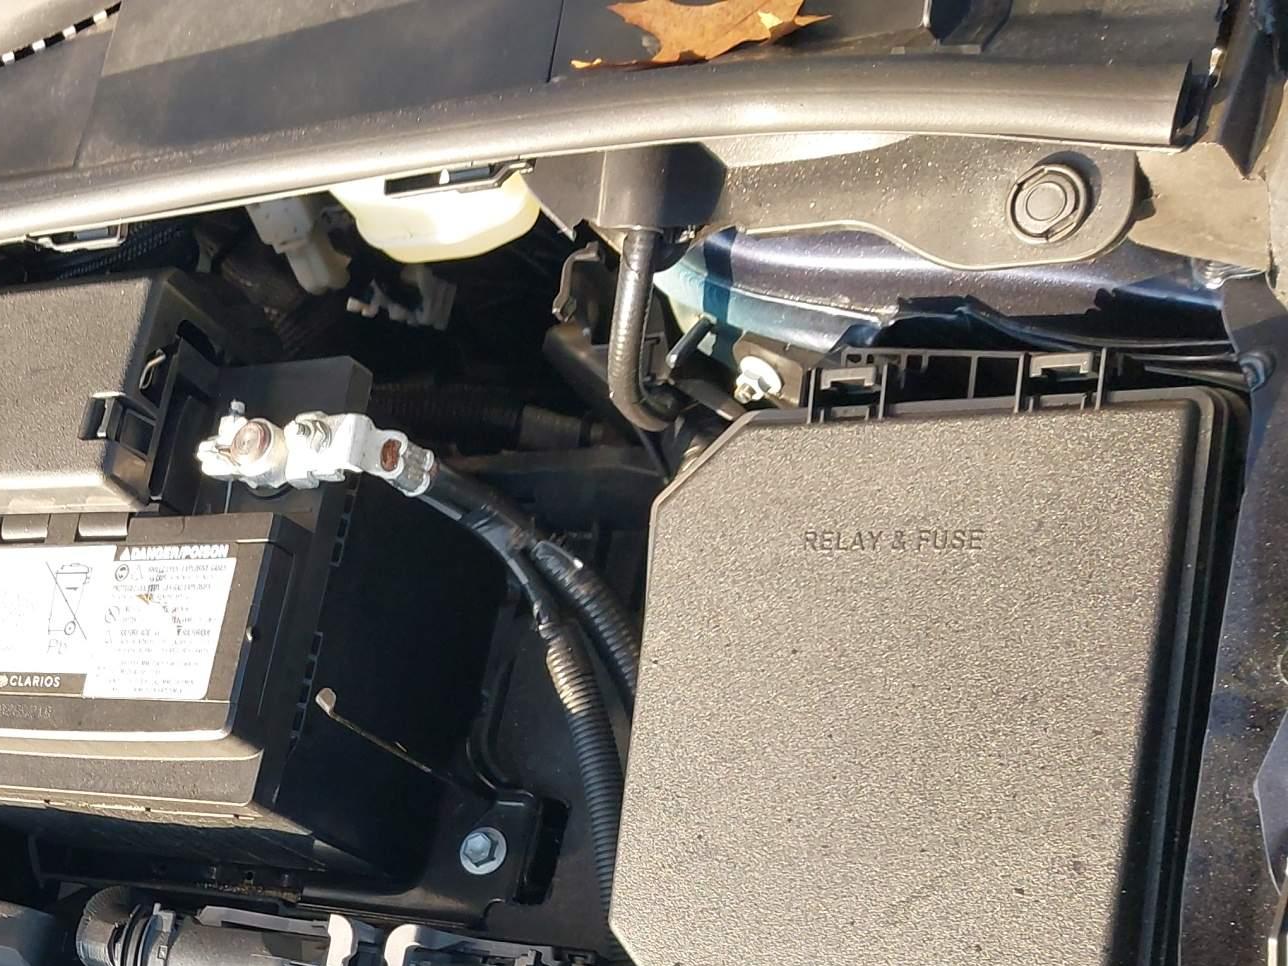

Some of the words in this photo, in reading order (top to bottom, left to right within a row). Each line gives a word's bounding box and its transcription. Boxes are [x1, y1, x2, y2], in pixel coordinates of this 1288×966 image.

[802, 530, 883, 552] RELAY
[890, 530, 907, 552] &
[916, 529, 986, 551] FUSE
[9, 675, 61, 688] CLARIOS
